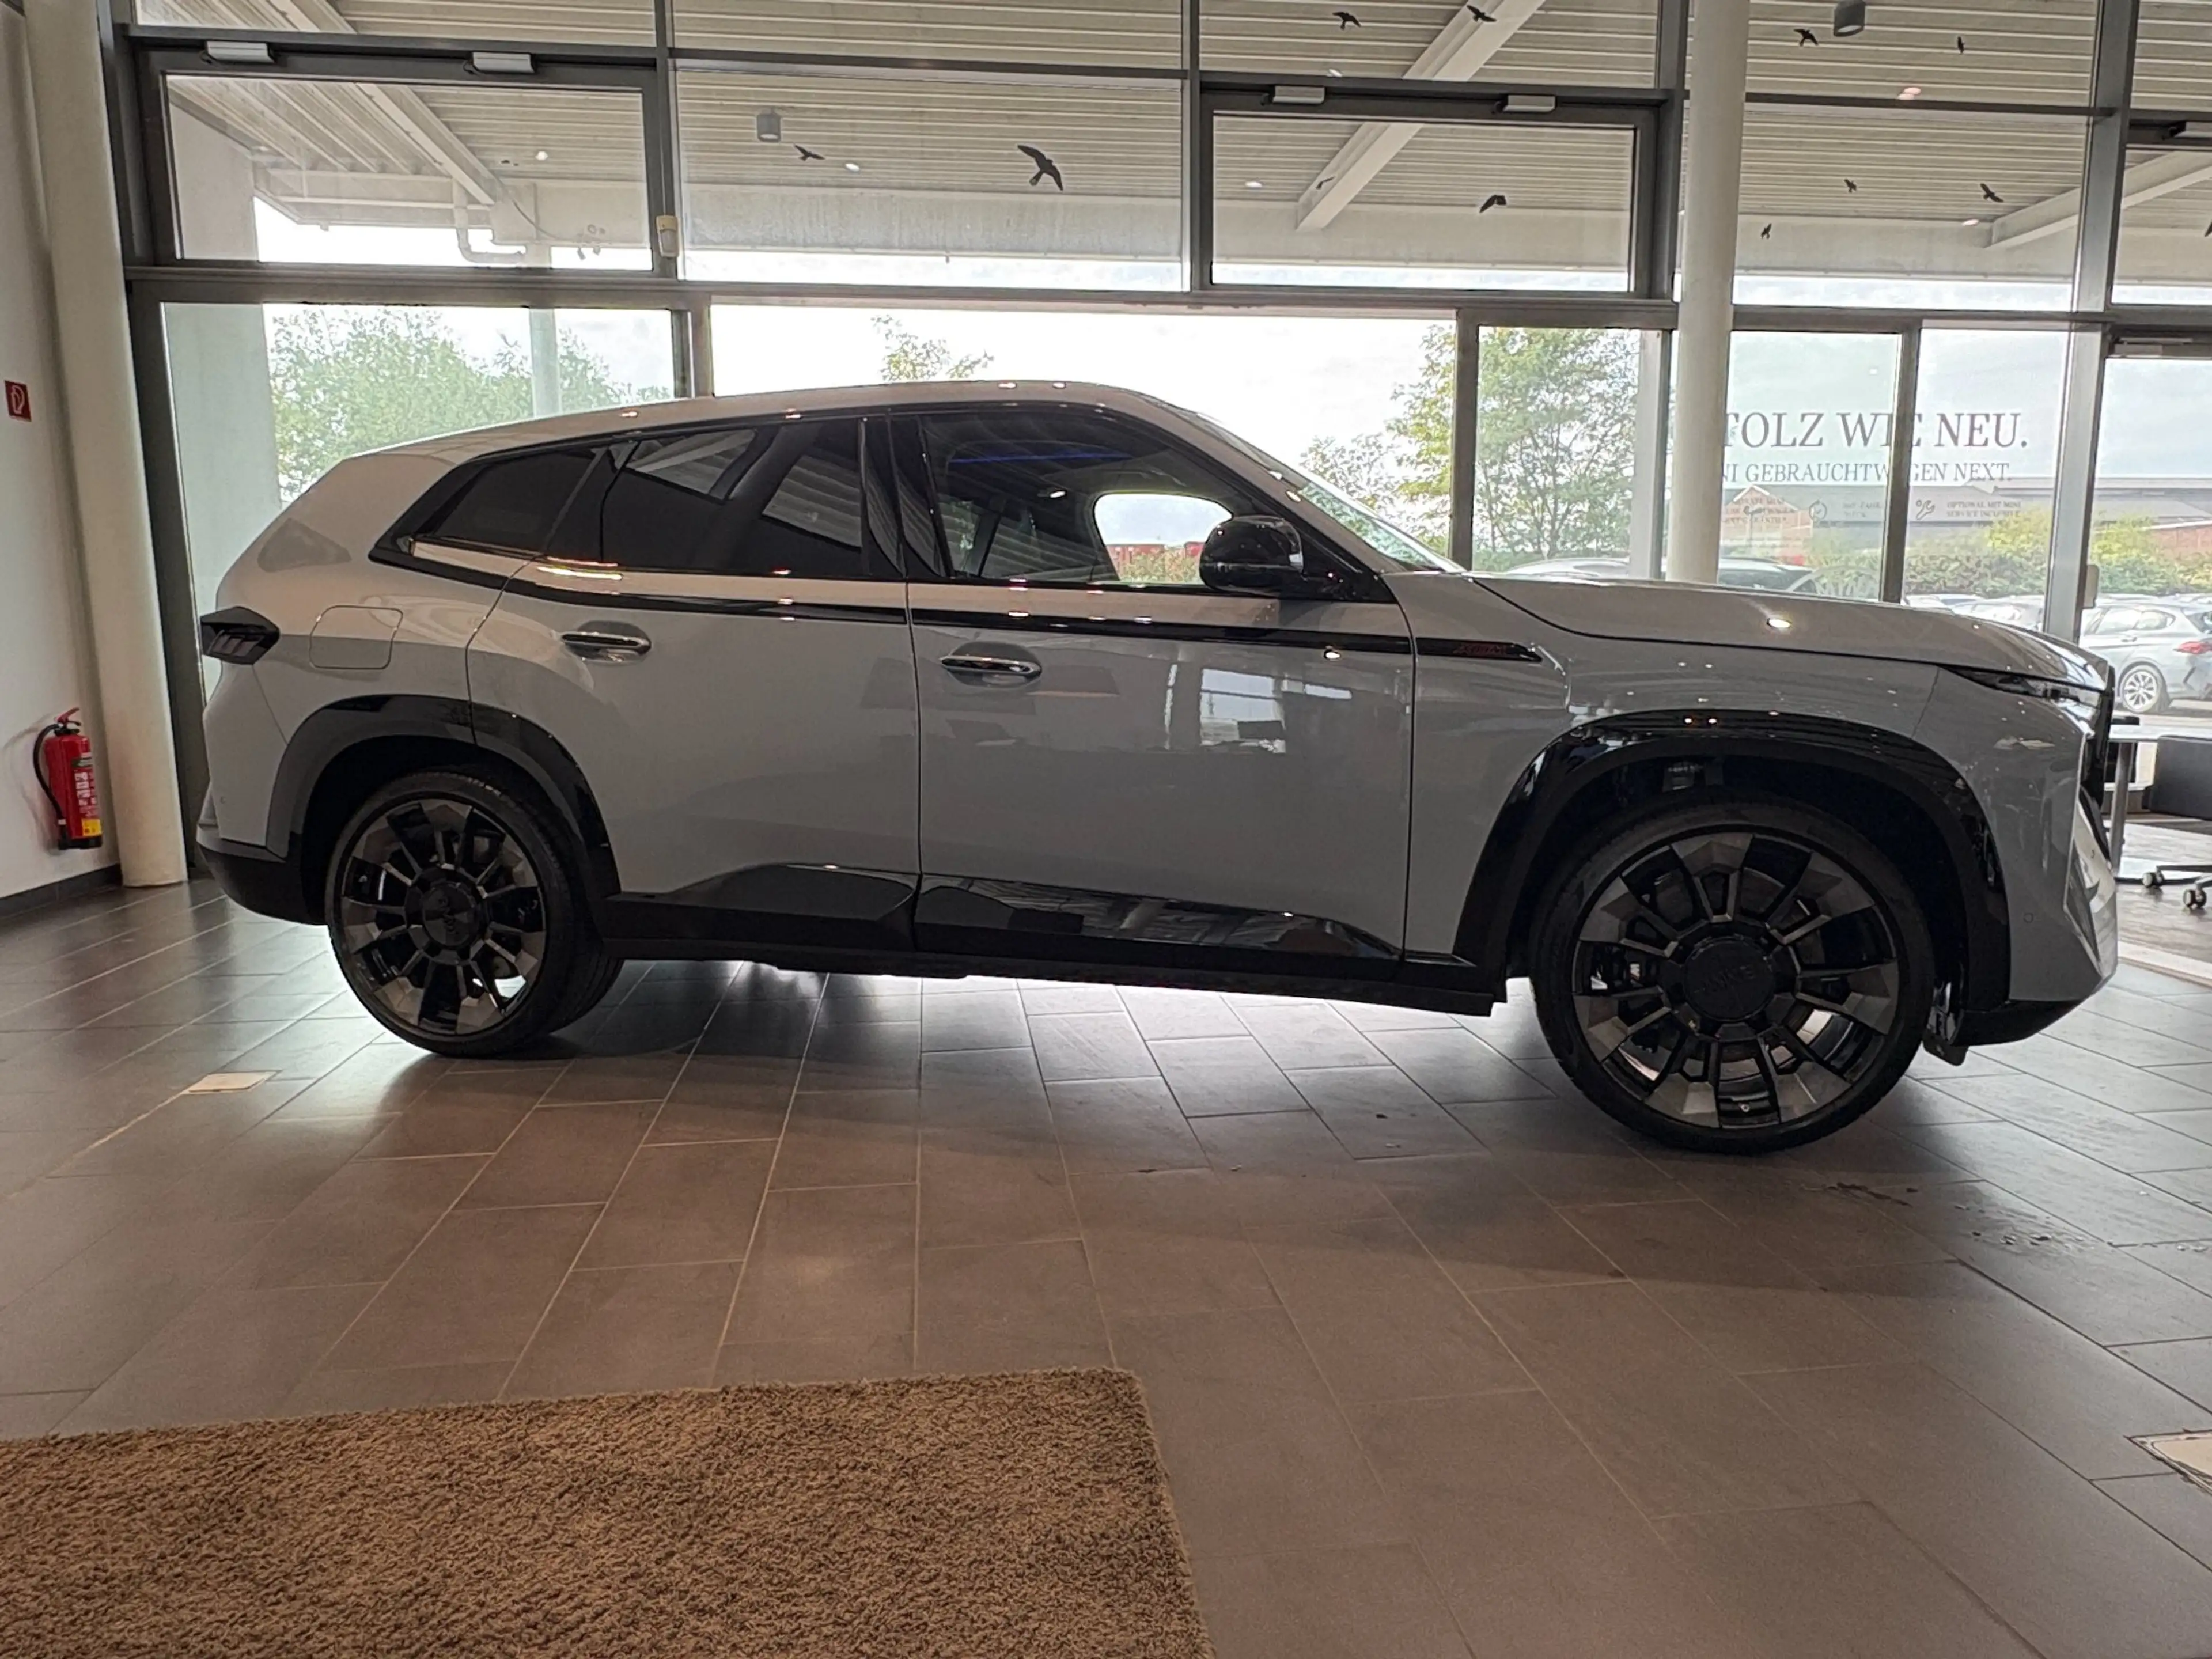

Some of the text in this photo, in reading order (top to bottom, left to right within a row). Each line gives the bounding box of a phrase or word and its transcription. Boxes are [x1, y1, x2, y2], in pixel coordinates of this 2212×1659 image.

[1724, 412, 1824, 448] TOLZ
[1934, 412, 2027, 448] NEU.
[1745, 463, 1949, 482] GEBRAUCHTWEN
[1953, 463, 2012, 482] NEXT.
